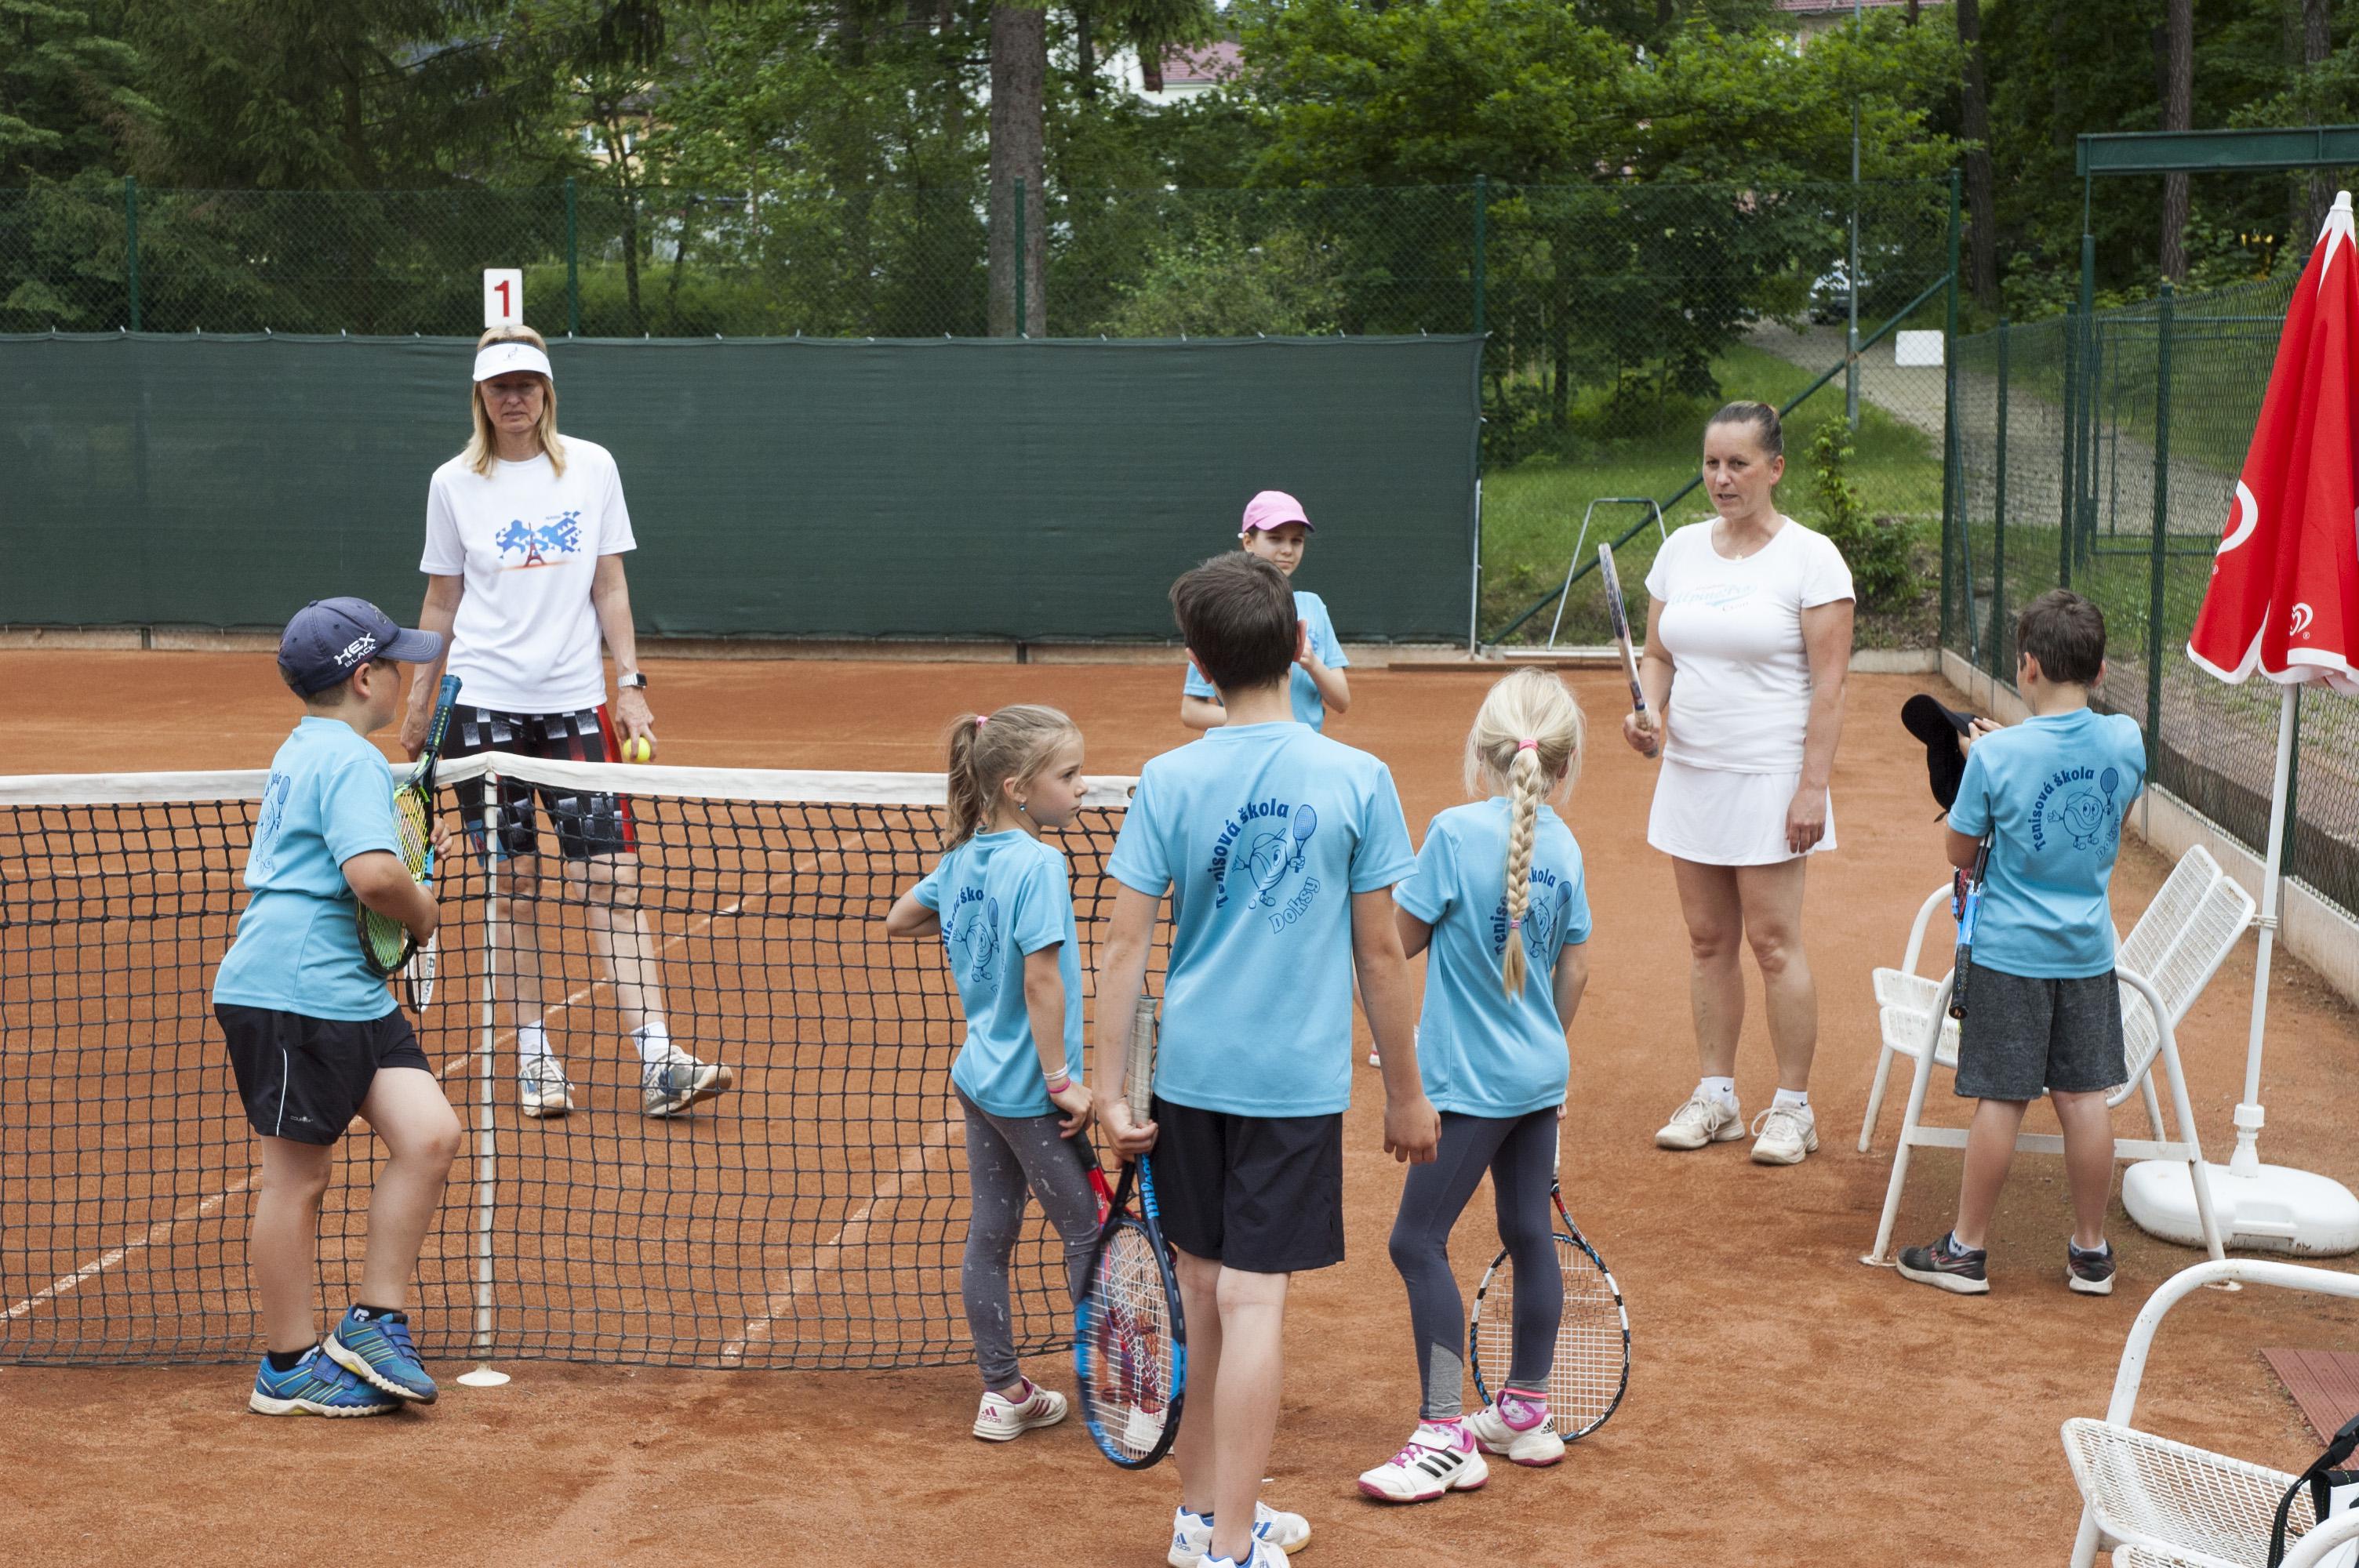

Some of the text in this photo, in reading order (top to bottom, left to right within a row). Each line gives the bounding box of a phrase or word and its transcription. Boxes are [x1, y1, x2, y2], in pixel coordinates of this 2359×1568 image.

[494, 280, 510, 318] 1
[333, 633, 376, 665] HEX
[344, 644, 376, 667] BLACK
[1238, 798, 1289, 824] škola
[2028, 766, 2094, 851] Tenisová škola
[1269, 877, 1321, 935] Doksy
